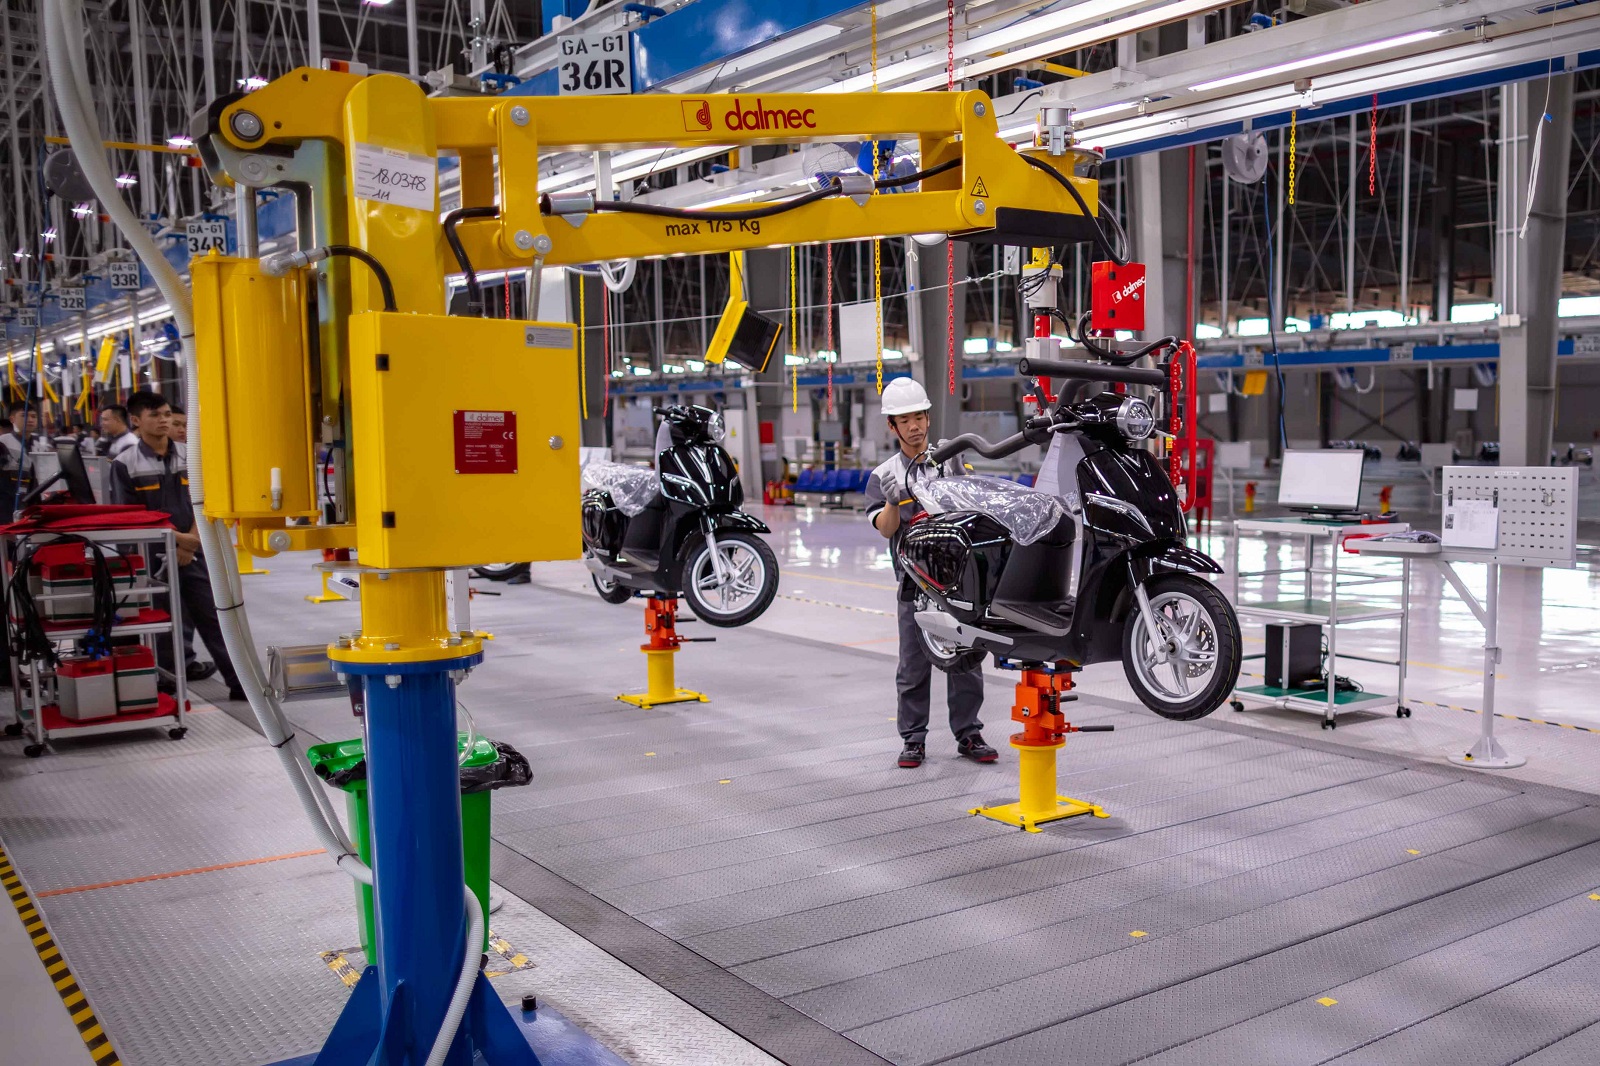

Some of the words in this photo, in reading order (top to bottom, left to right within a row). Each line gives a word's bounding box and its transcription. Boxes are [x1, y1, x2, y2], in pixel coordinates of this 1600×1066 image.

[562, 35, 623, 55] GA-G1
[562, 59, 626, 91] 36R
[725, 98, 817, 131] dalmec
[189, 225, 222, 233] GA-G1
[665, 223, 700, 236] max
[188, 237, 224, 253] 34R
[112, 273, 138, 286] 33R
[61, 297, 84, 308] 32R
[477, 413, 504, 422] dalmec
[502, 431, 514, 440] CE
